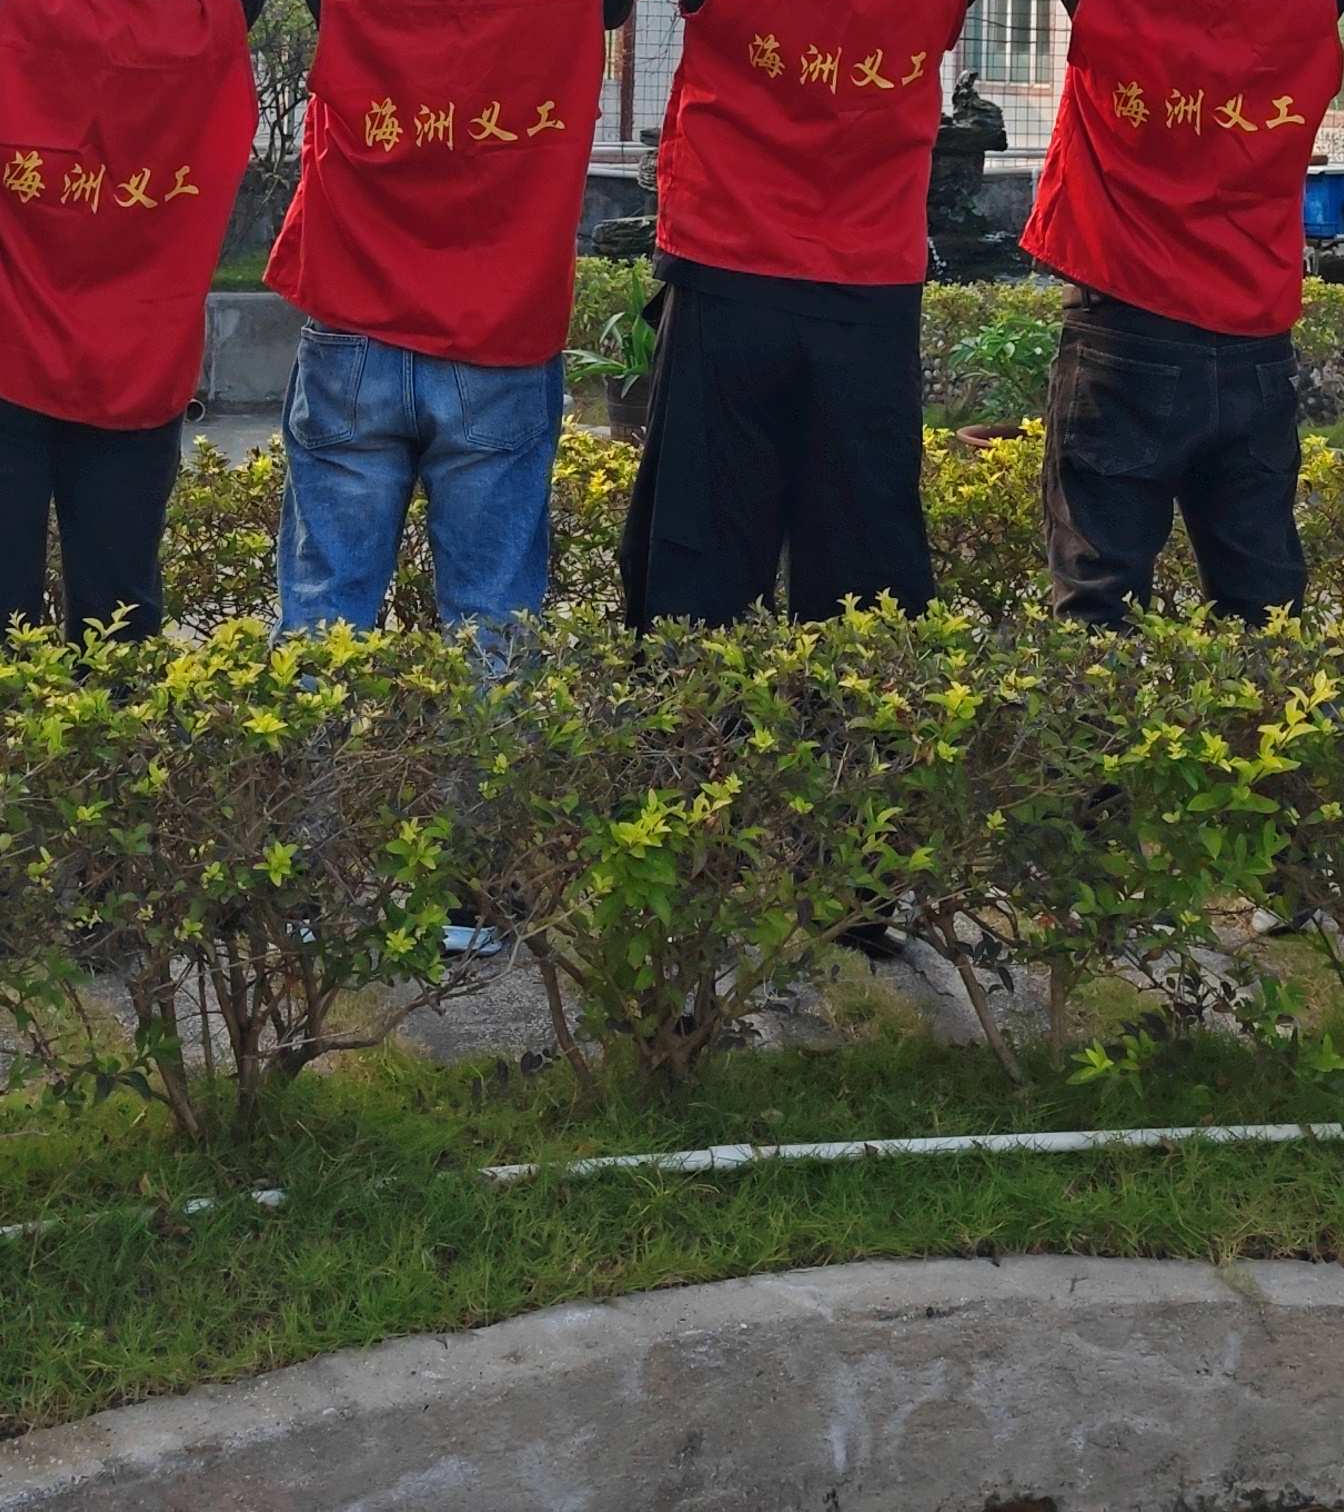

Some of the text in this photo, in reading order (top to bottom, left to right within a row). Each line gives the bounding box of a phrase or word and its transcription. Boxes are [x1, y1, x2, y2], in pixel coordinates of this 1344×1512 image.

[748, 33, 927, 95] 海洲义工
[364, 97, 566, 152] 海洲义工
[1112, 81, 1305, 136] 海洲义工
[3, 150, 199, 215] 海洲义工
